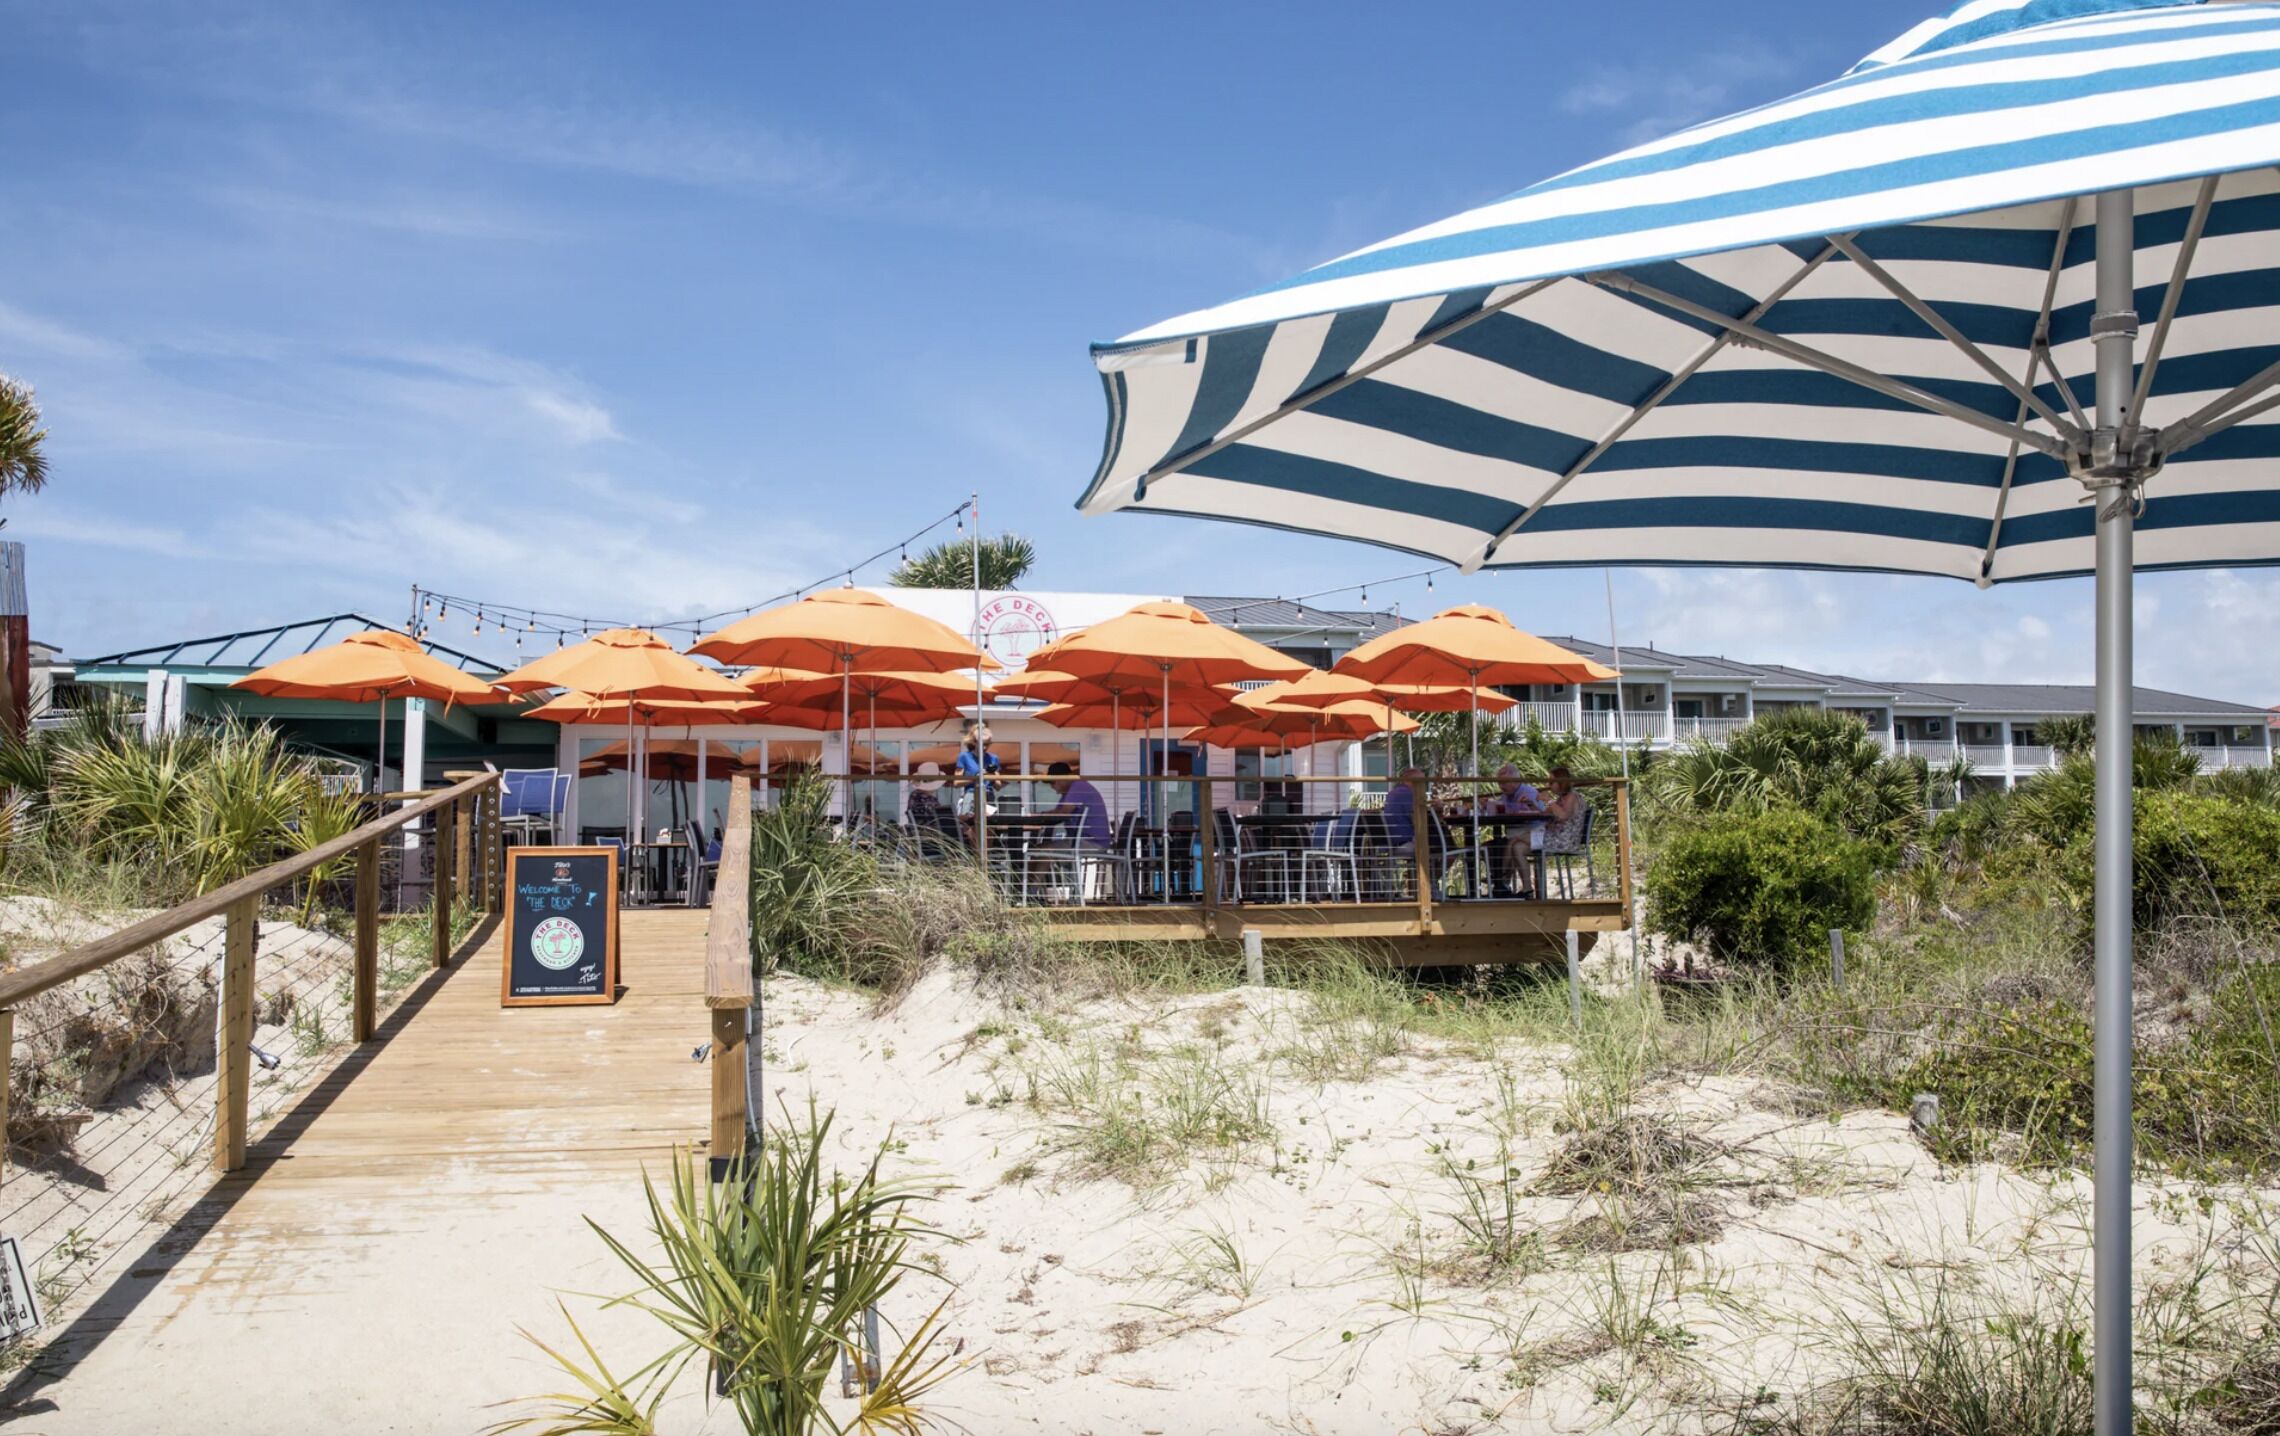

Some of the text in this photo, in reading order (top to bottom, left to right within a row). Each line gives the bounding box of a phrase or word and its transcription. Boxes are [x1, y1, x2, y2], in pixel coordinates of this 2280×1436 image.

[1013, 600, 1052, 632] DECK
[518, 884, 560, 894] WELCOME
[536, 920, 580, 940] THE DECK
